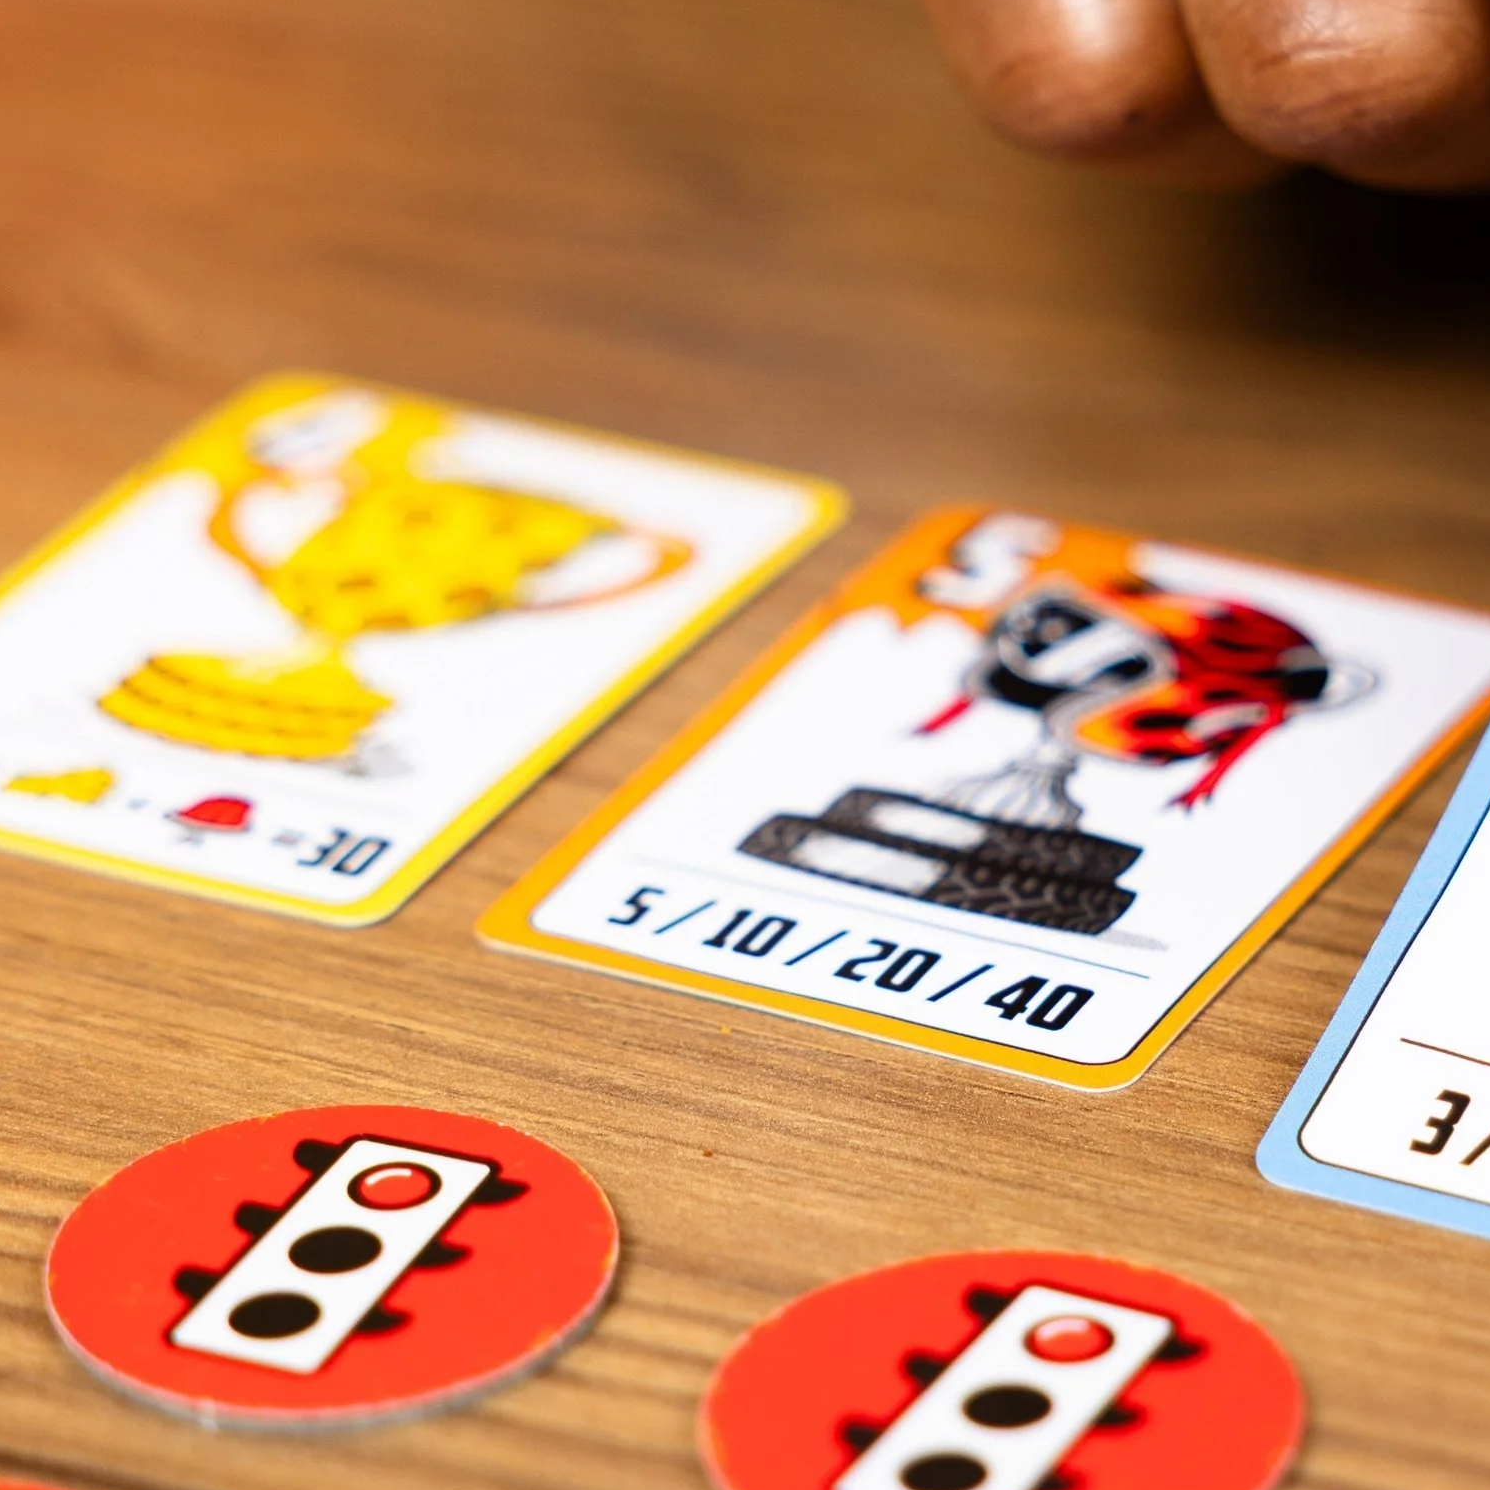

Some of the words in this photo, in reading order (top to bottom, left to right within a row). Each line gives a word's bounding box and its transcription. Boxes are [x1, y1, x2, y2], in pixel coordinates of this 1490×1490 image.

[608, 887, 666, 926] 5
[701, 909, 799, 959] 10
[832, 938, 942, 993] 20
[983, 975, 1095, 1031] 40
[1409, 1089, 1472, 1156] 3
